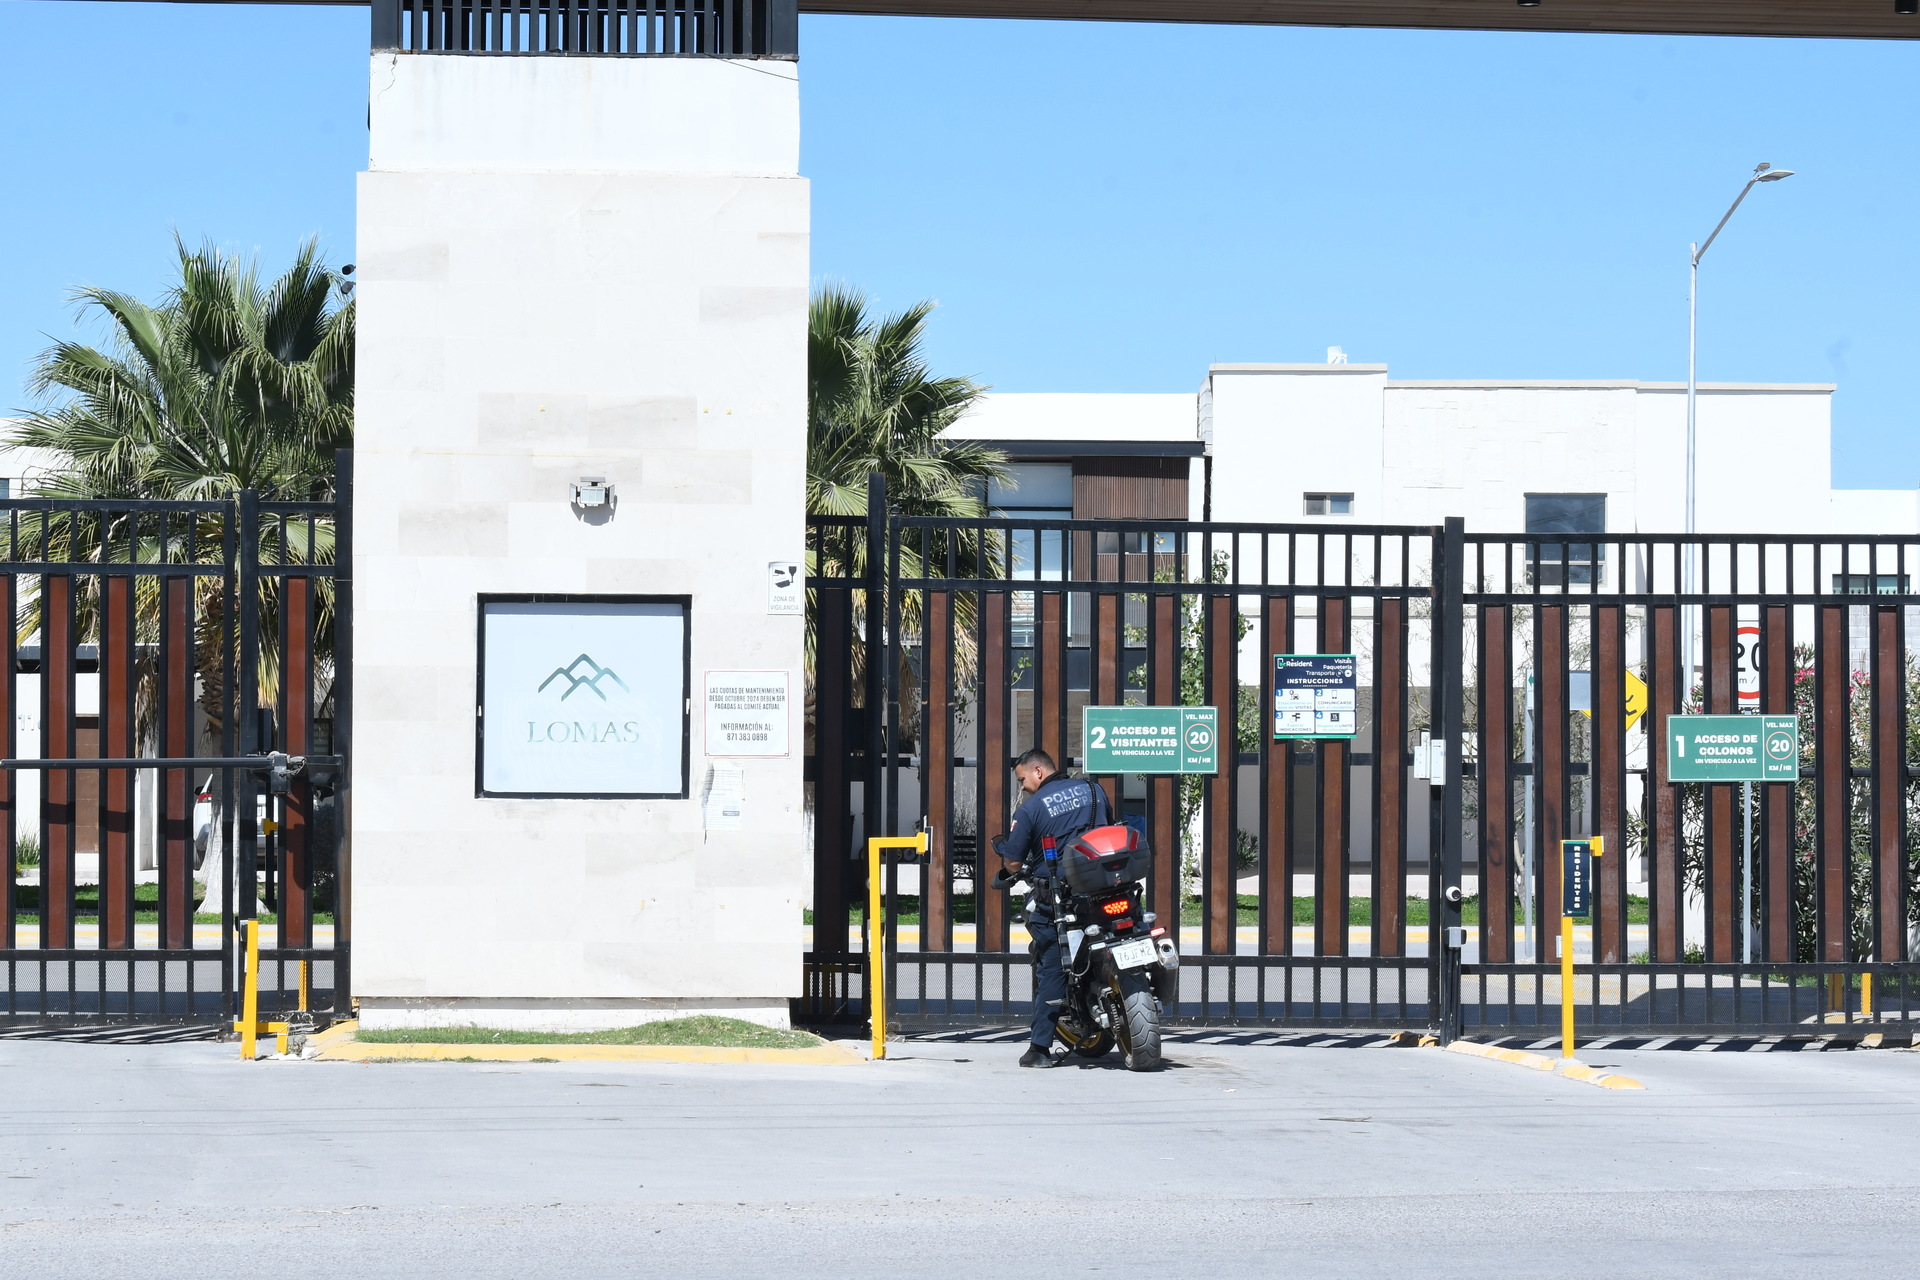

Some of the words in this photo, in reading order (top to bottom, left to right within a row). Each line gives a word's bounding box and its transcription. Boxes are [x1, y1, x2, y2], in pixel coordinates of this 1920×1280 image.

[528, 721, 640, 743] LOMAS
[721, 722, 763, 731] INFORMACIÓN
[1112, 726, 1158, 735] ACCESO
[1161, 727, 1176, 735] DE
[1090, 726, 1106, 748] 2
[1190, 732, 1209, 745] 20
[1694, 735, 1740, 743] ACCESO
[1743, 735, 1758, 743] DE
[1110, 739, 1178, 747] VISITANTES
[1675, 735, 1685, 757] 1
[1771, 739, 1790, 752] 20
[1699, 747, 1753, 755] COLONOS
